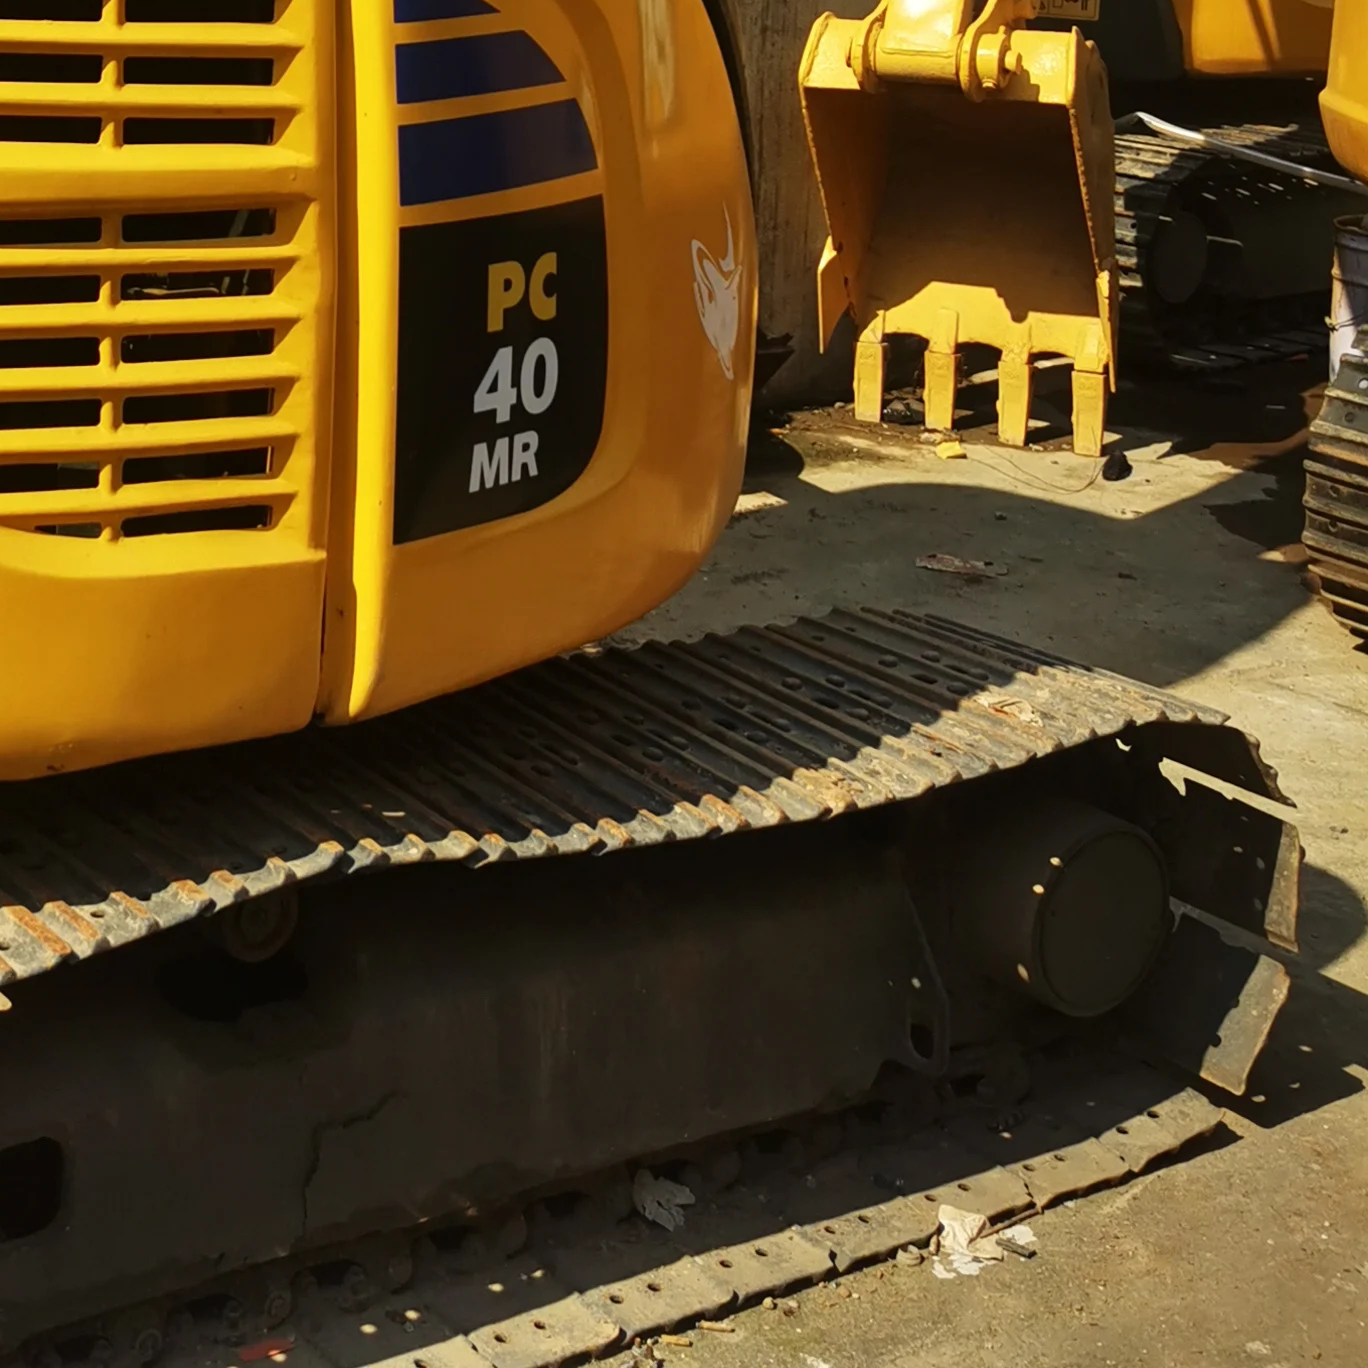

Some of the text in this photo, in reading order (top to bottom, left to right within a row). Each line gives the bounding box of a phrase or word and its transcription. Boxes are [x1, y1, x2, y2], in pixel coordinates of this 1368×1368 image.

[487, 251, 557, 333] PC
[473, 336, 559, 424] 40
[468, 430, 539, 493] MR
